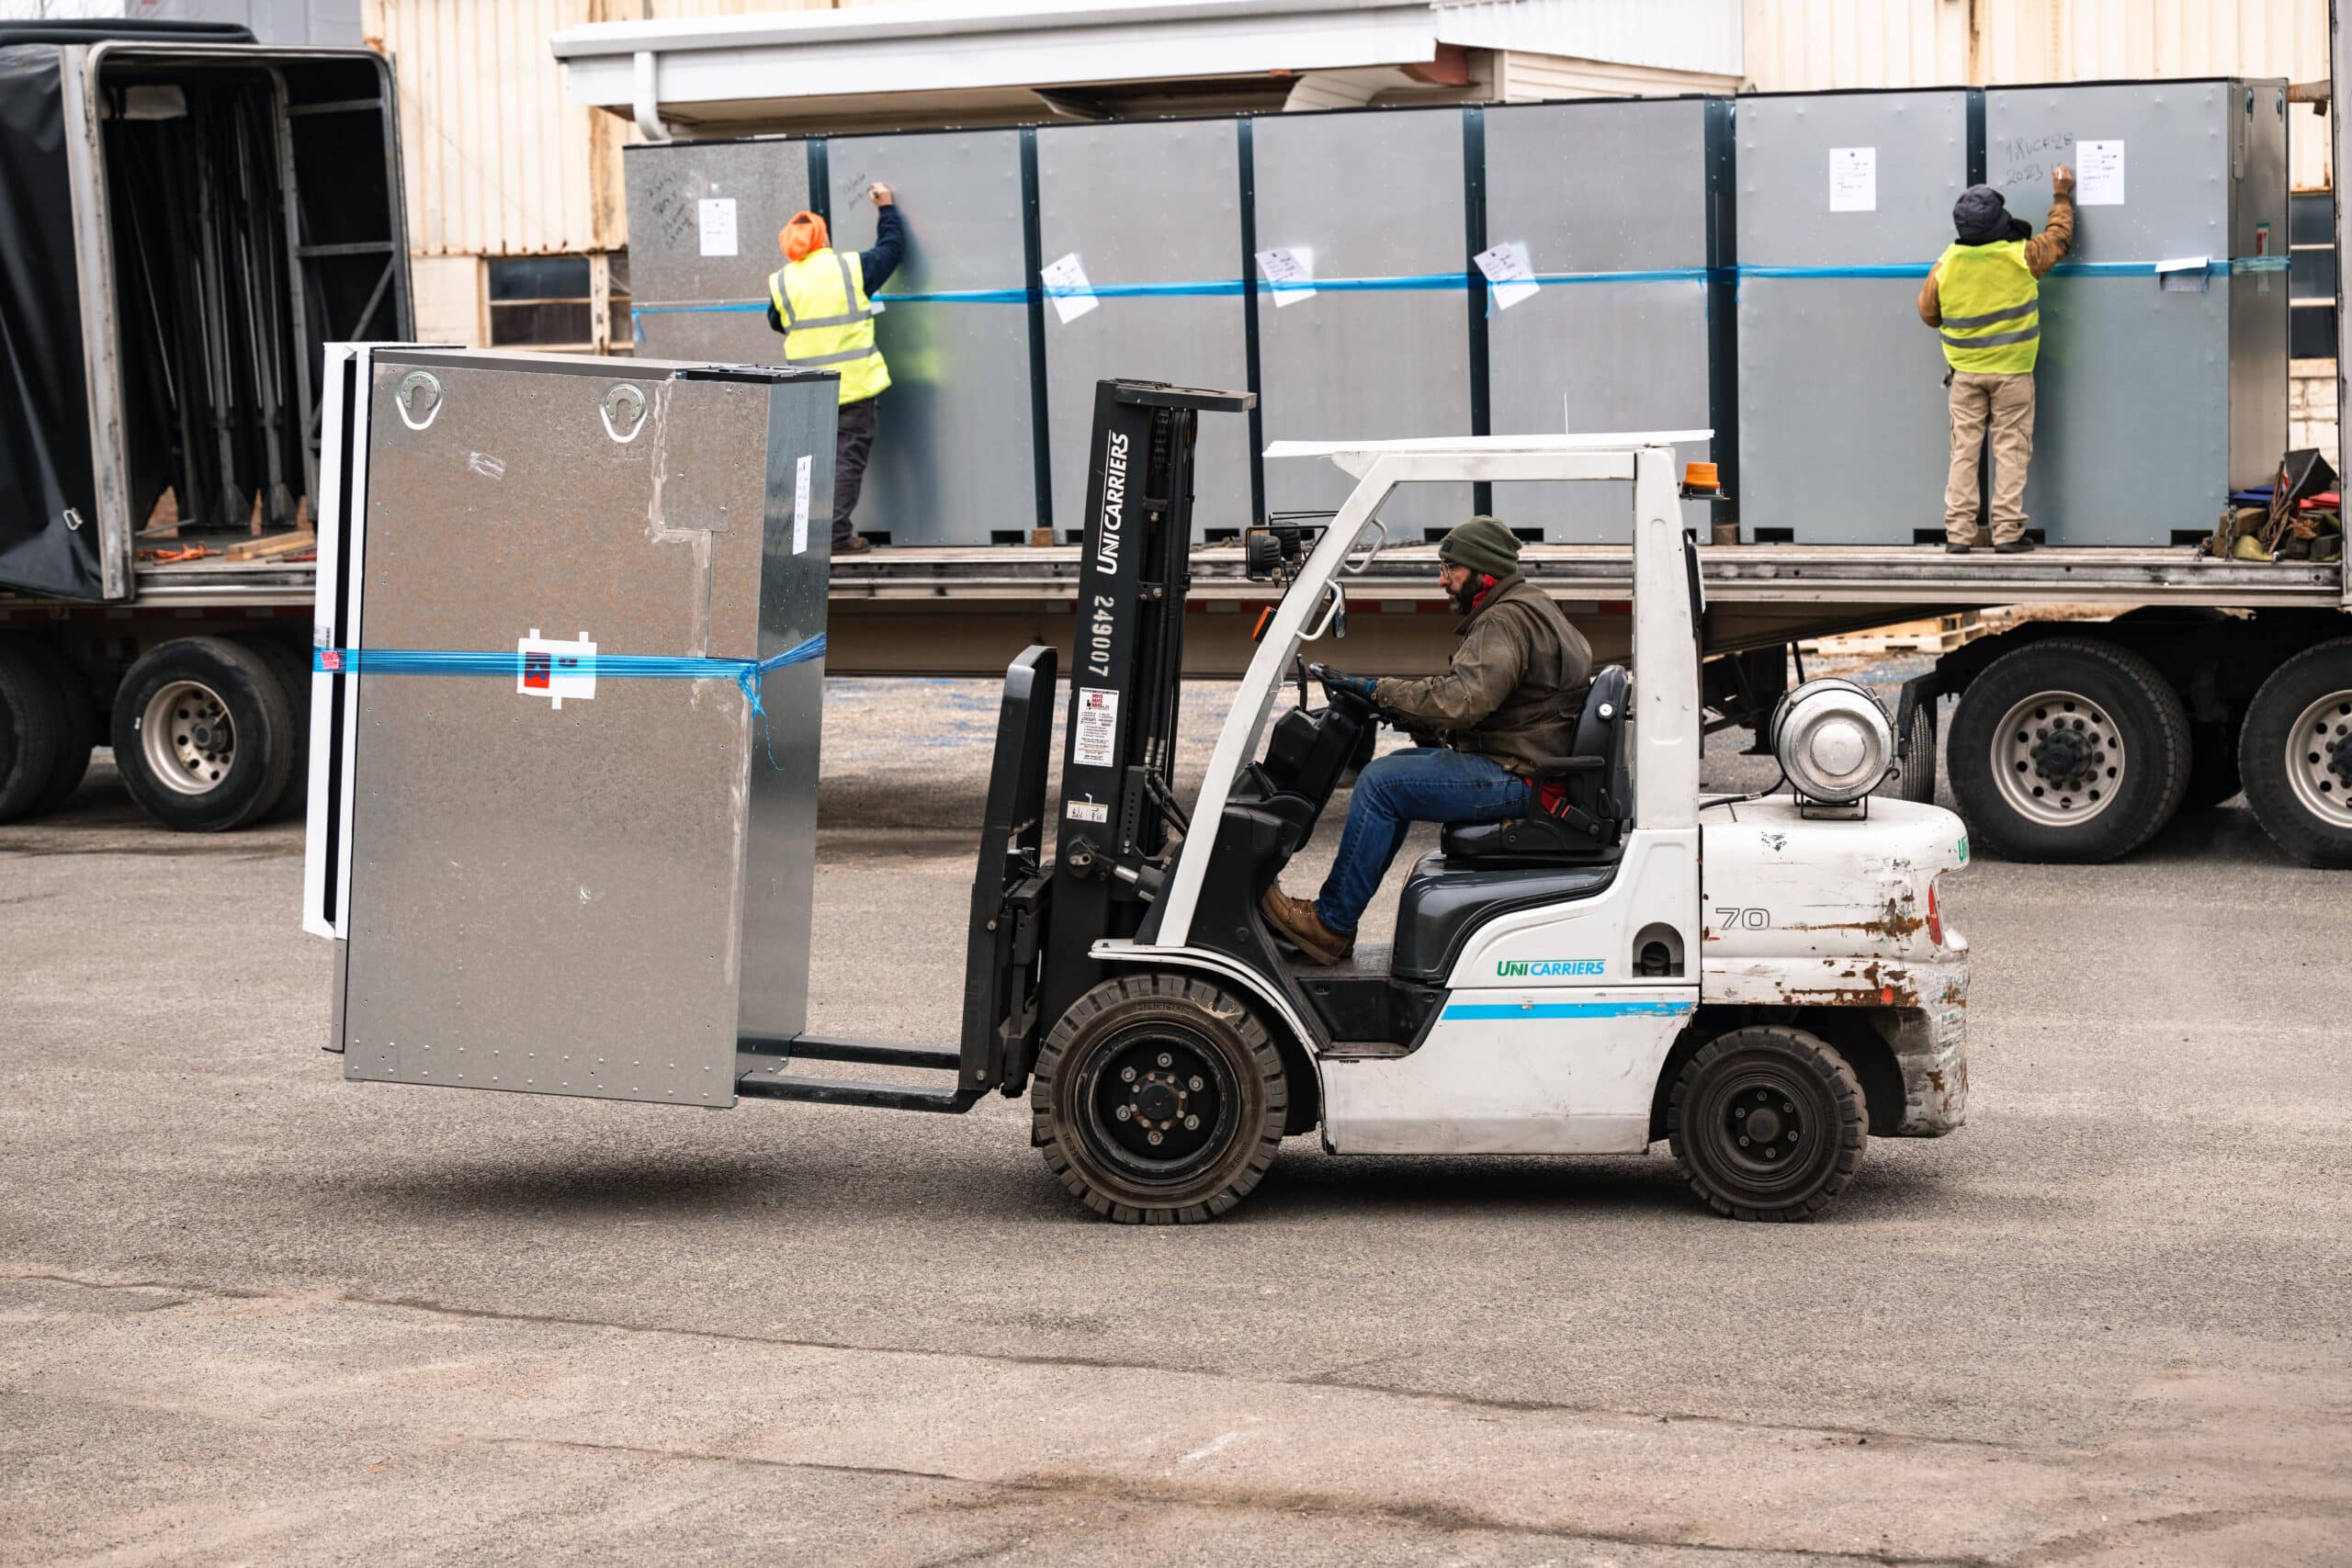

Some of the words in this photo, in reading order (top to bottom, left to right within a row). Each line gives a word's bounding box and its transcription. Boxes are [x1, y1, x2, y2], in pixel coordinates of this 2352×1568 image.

[1096, 429, 1129, 575] UNICARRIERS
[1088, 594, 1115, 677] 249007
[1715, 908, 1770, 931] 70
